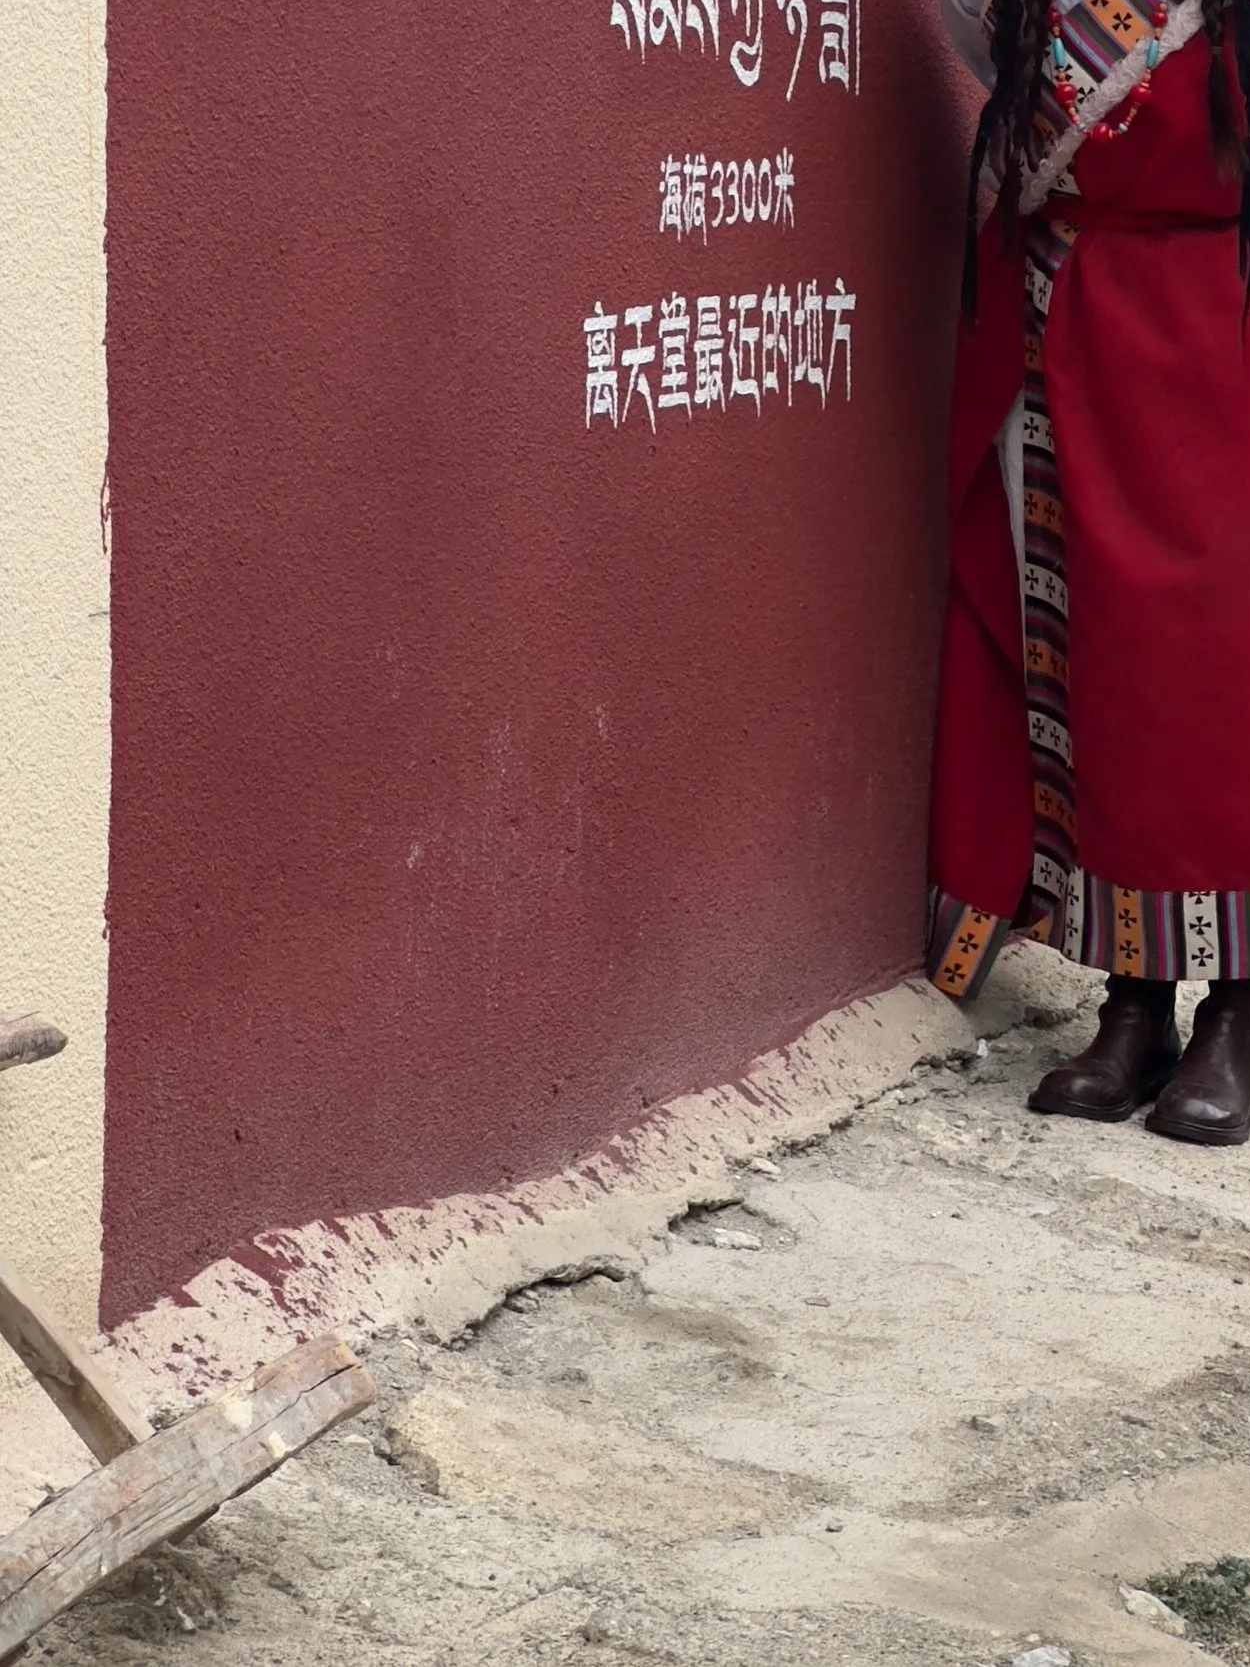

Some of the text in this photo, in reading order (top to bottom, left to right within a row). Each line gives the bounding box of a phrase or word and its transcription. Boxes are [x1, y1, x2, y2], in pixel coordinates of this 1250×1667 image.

[659, 147, 795, 245] 海拔3300米
[583, 277, 857, 434] 离天堂最近的地方
